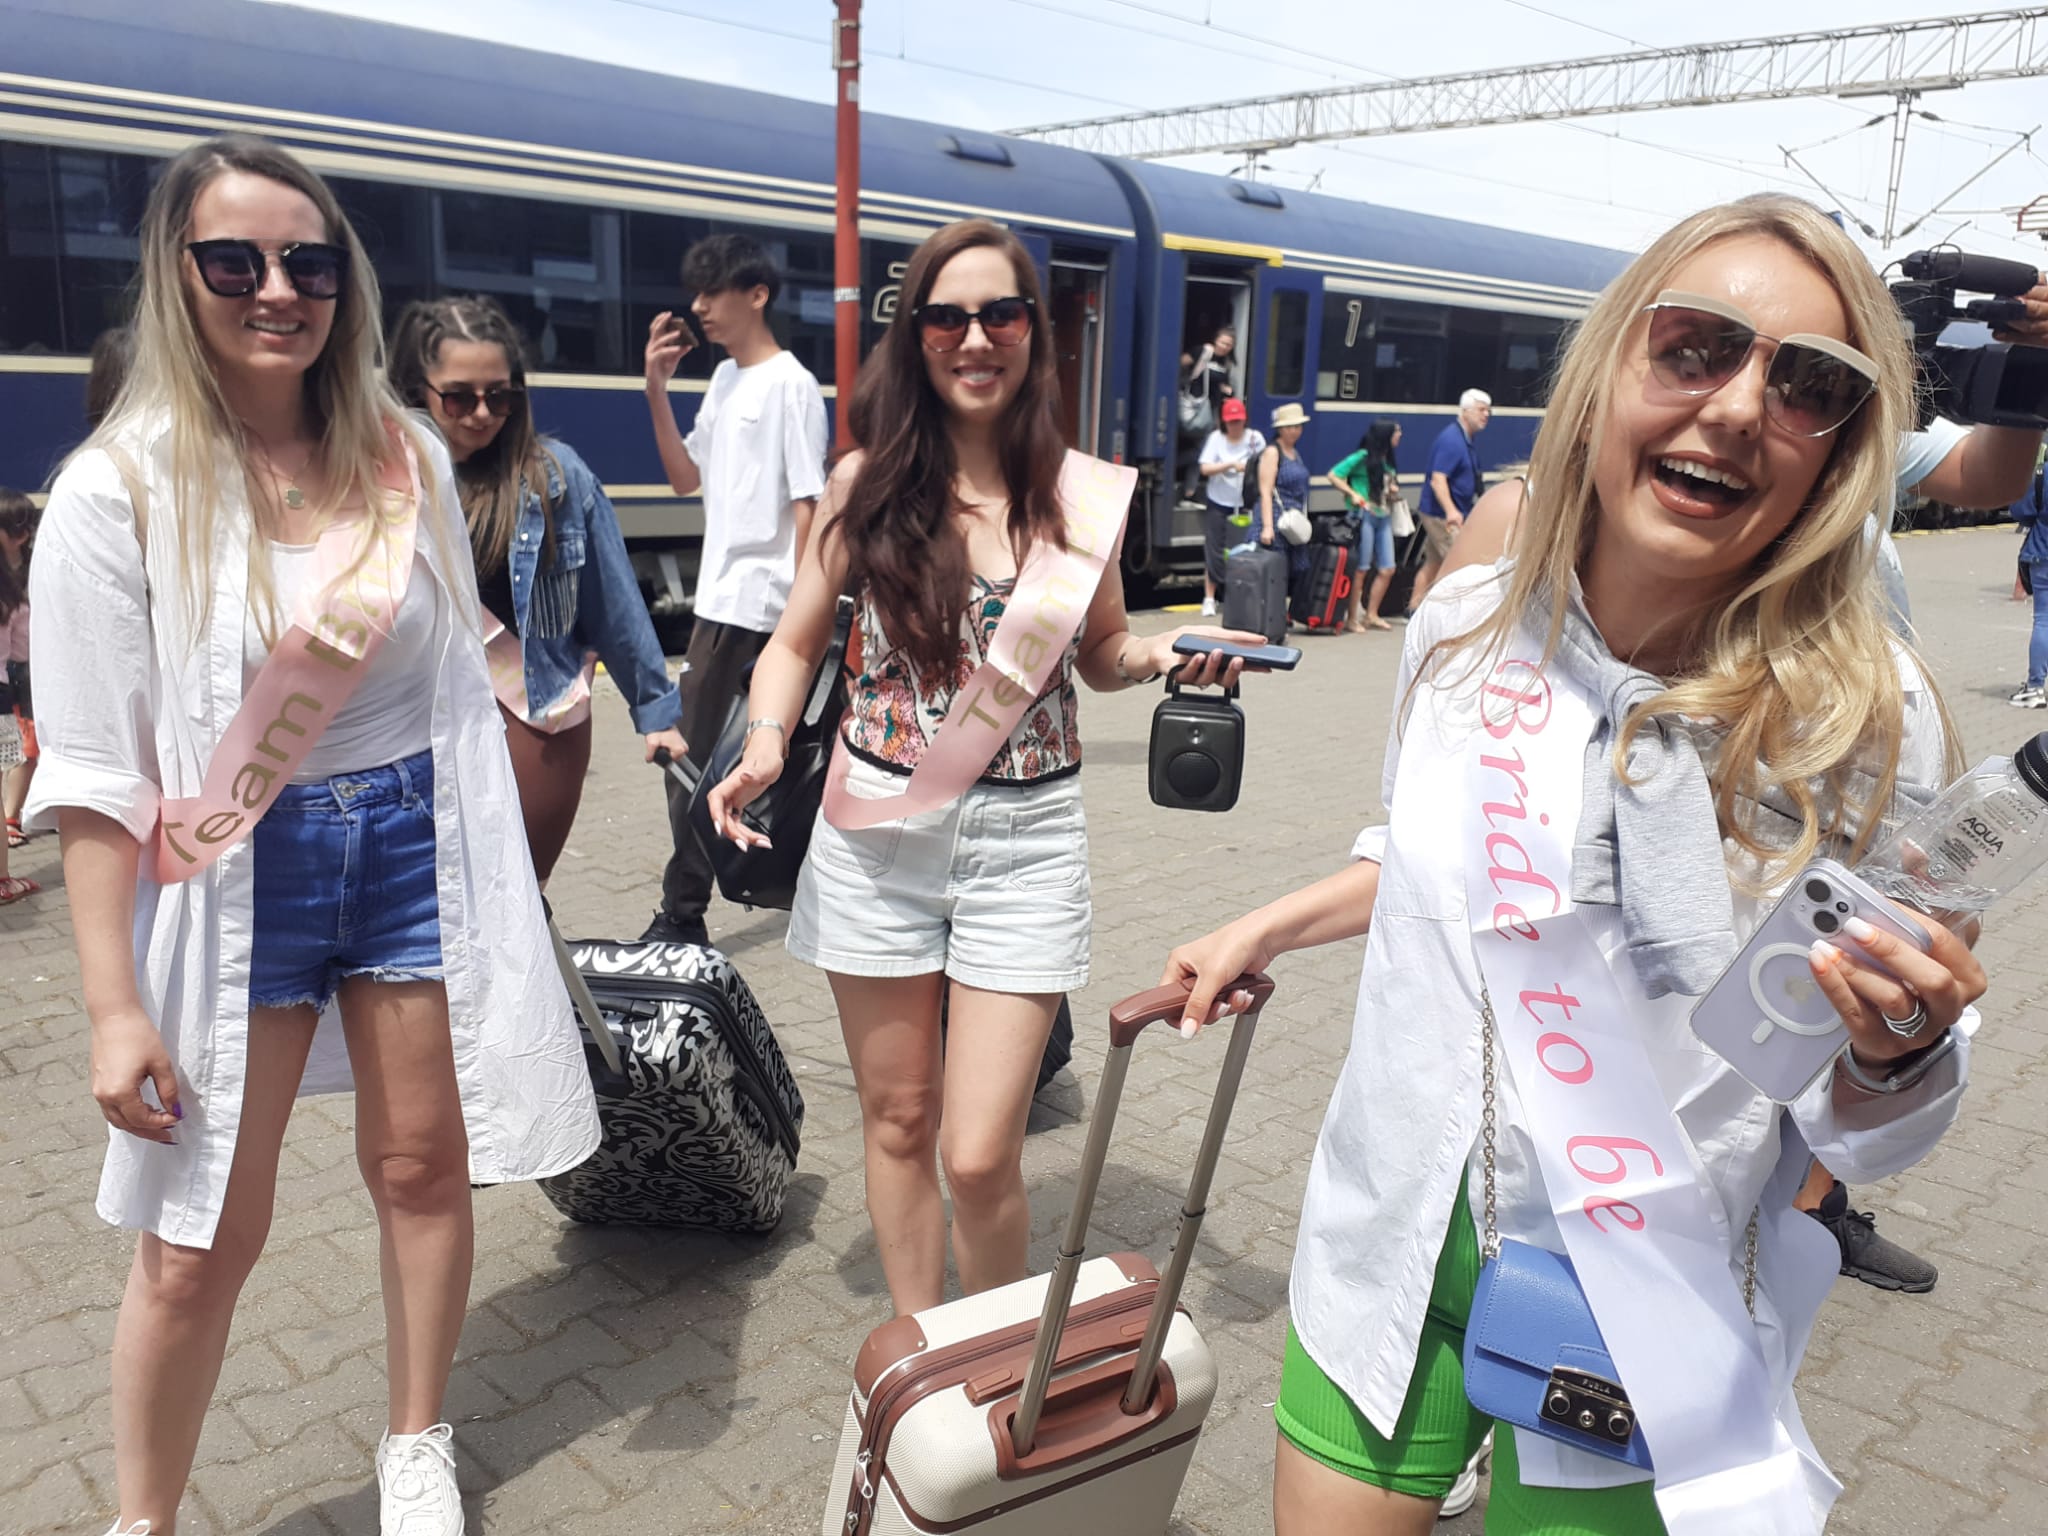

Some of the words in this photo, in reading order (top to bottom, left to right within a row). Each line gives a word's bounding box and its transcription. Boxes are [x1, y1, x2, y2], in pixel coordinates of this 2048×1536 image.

[958, 576, 1080, 730] Team
[163, 692, 324, 865] Team
[1479, 658, 1562, 943] Bride
[1956, 822, 1996, 858] CARPATICA
[1962, 816, 2006, 854] AQUA
[1518, 981, 1594, 1085] to
[1566, 1134, 1664, 1234] be
